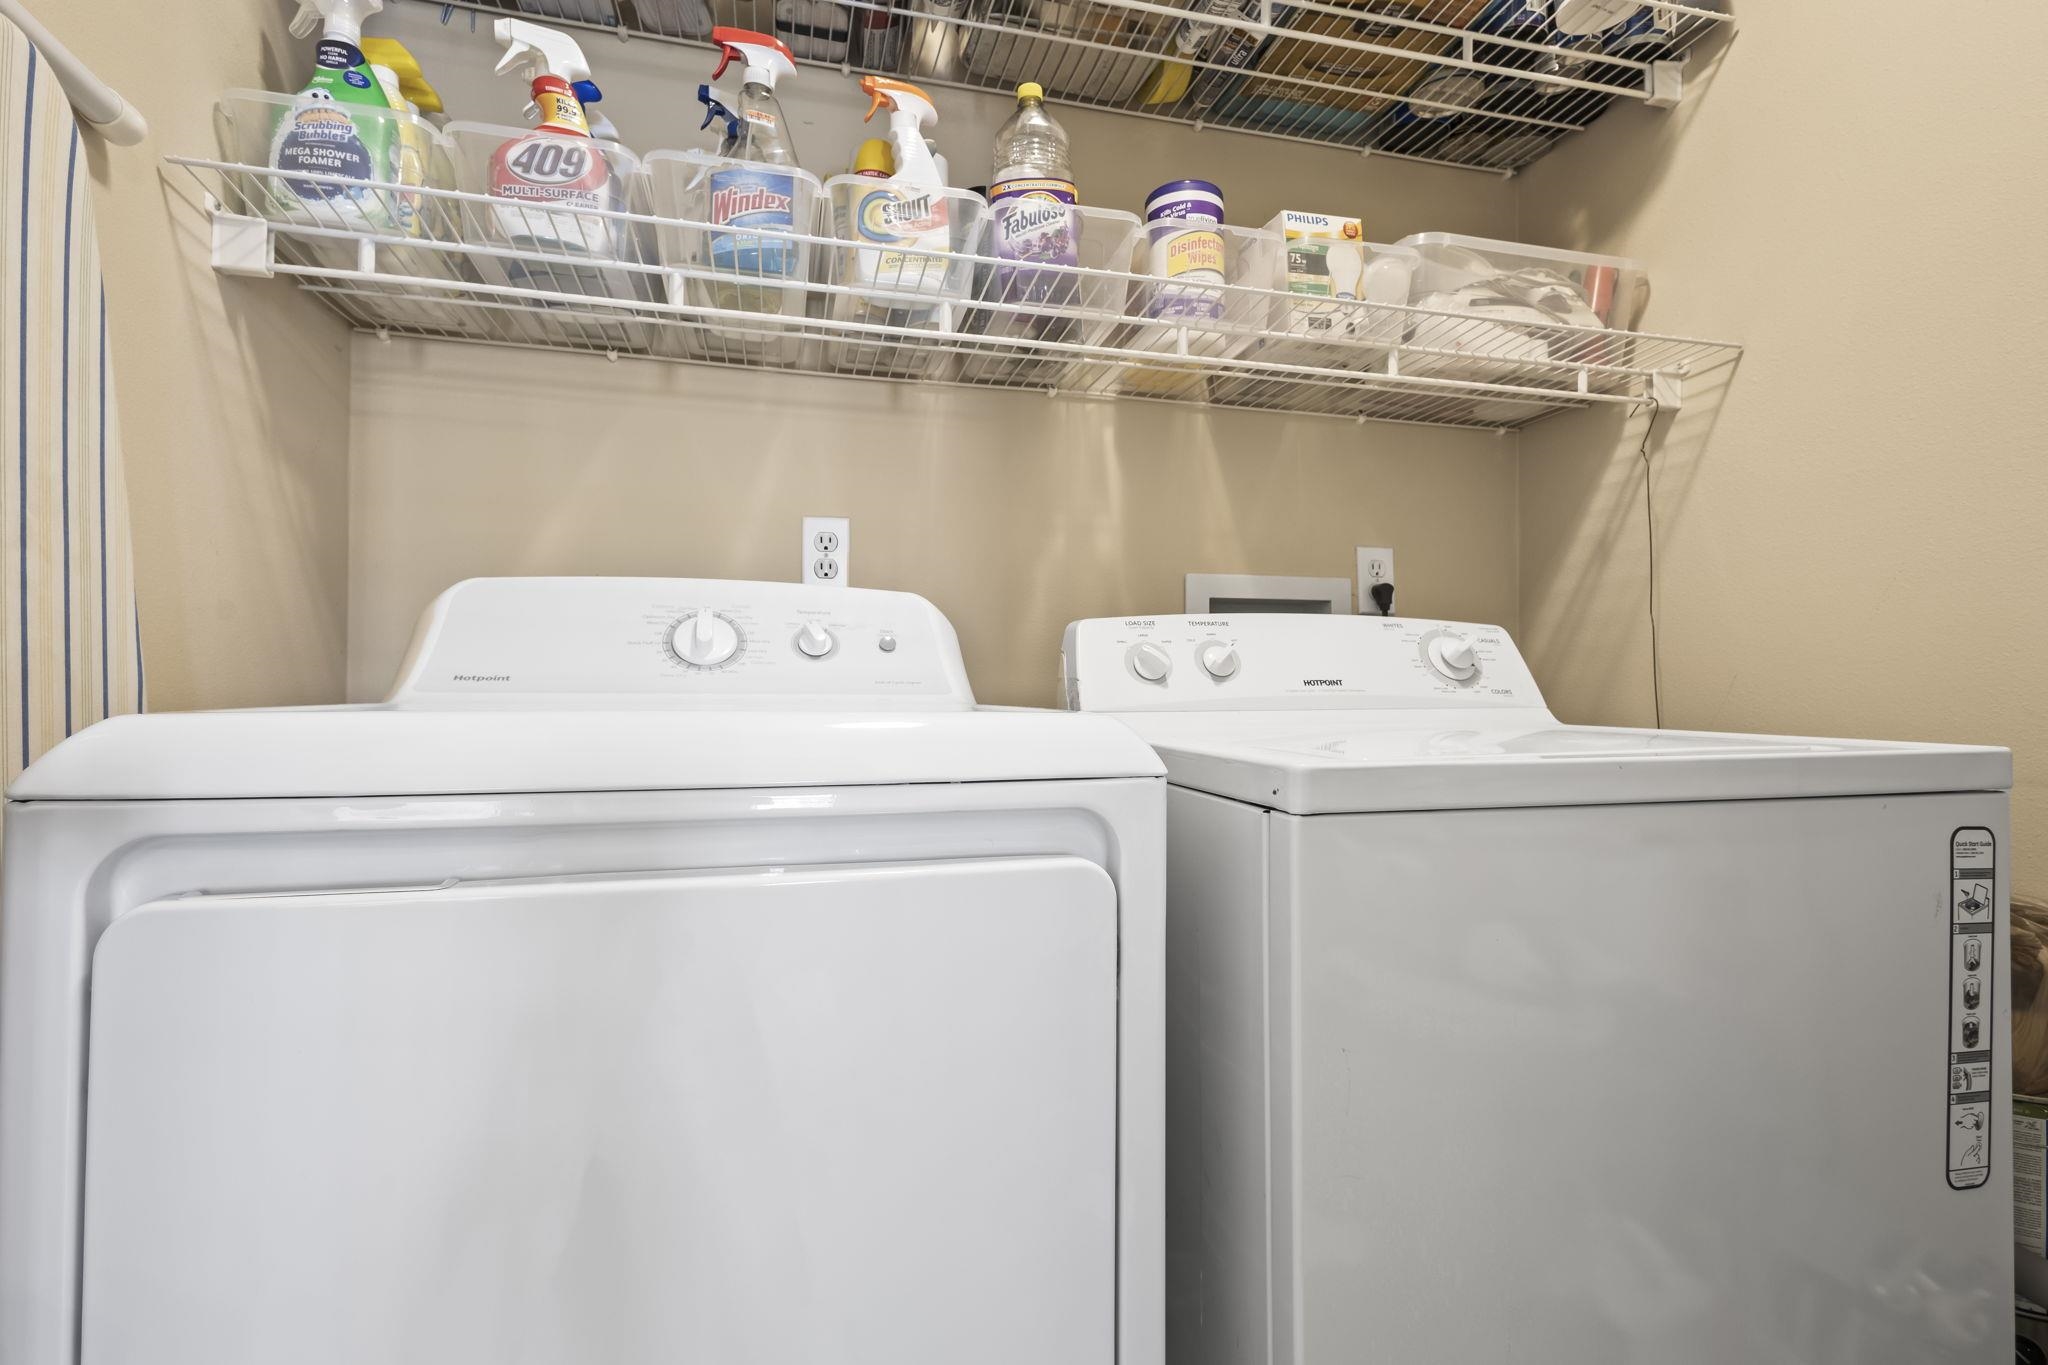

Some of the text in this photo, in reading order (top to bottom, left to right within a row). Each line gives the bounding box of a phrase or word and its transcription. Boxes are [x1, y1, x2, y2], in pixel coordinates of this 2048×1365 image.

[295, 121, 353, 134] Scrubbing
[300, 131, 346, 140] Bubbles
[284, 147, 360, 163] MEGA SHOWER
[298, 156, 342, 167] FOAMER
[511, 143, 587, 178] 409
[502, 185, 600, 203] MULTI-SURFACE
[713, 186, 791, 225] Windex
[1002, 205, 1066, 240] Fabuloso
[1287, 213, 1329, 226] PHILIPS
[1187, 251, 1217, 265] Wipes
[453, 674, 511, 682] Hotpoint
[1302, 679, 1343, 687] HOTPOINT
